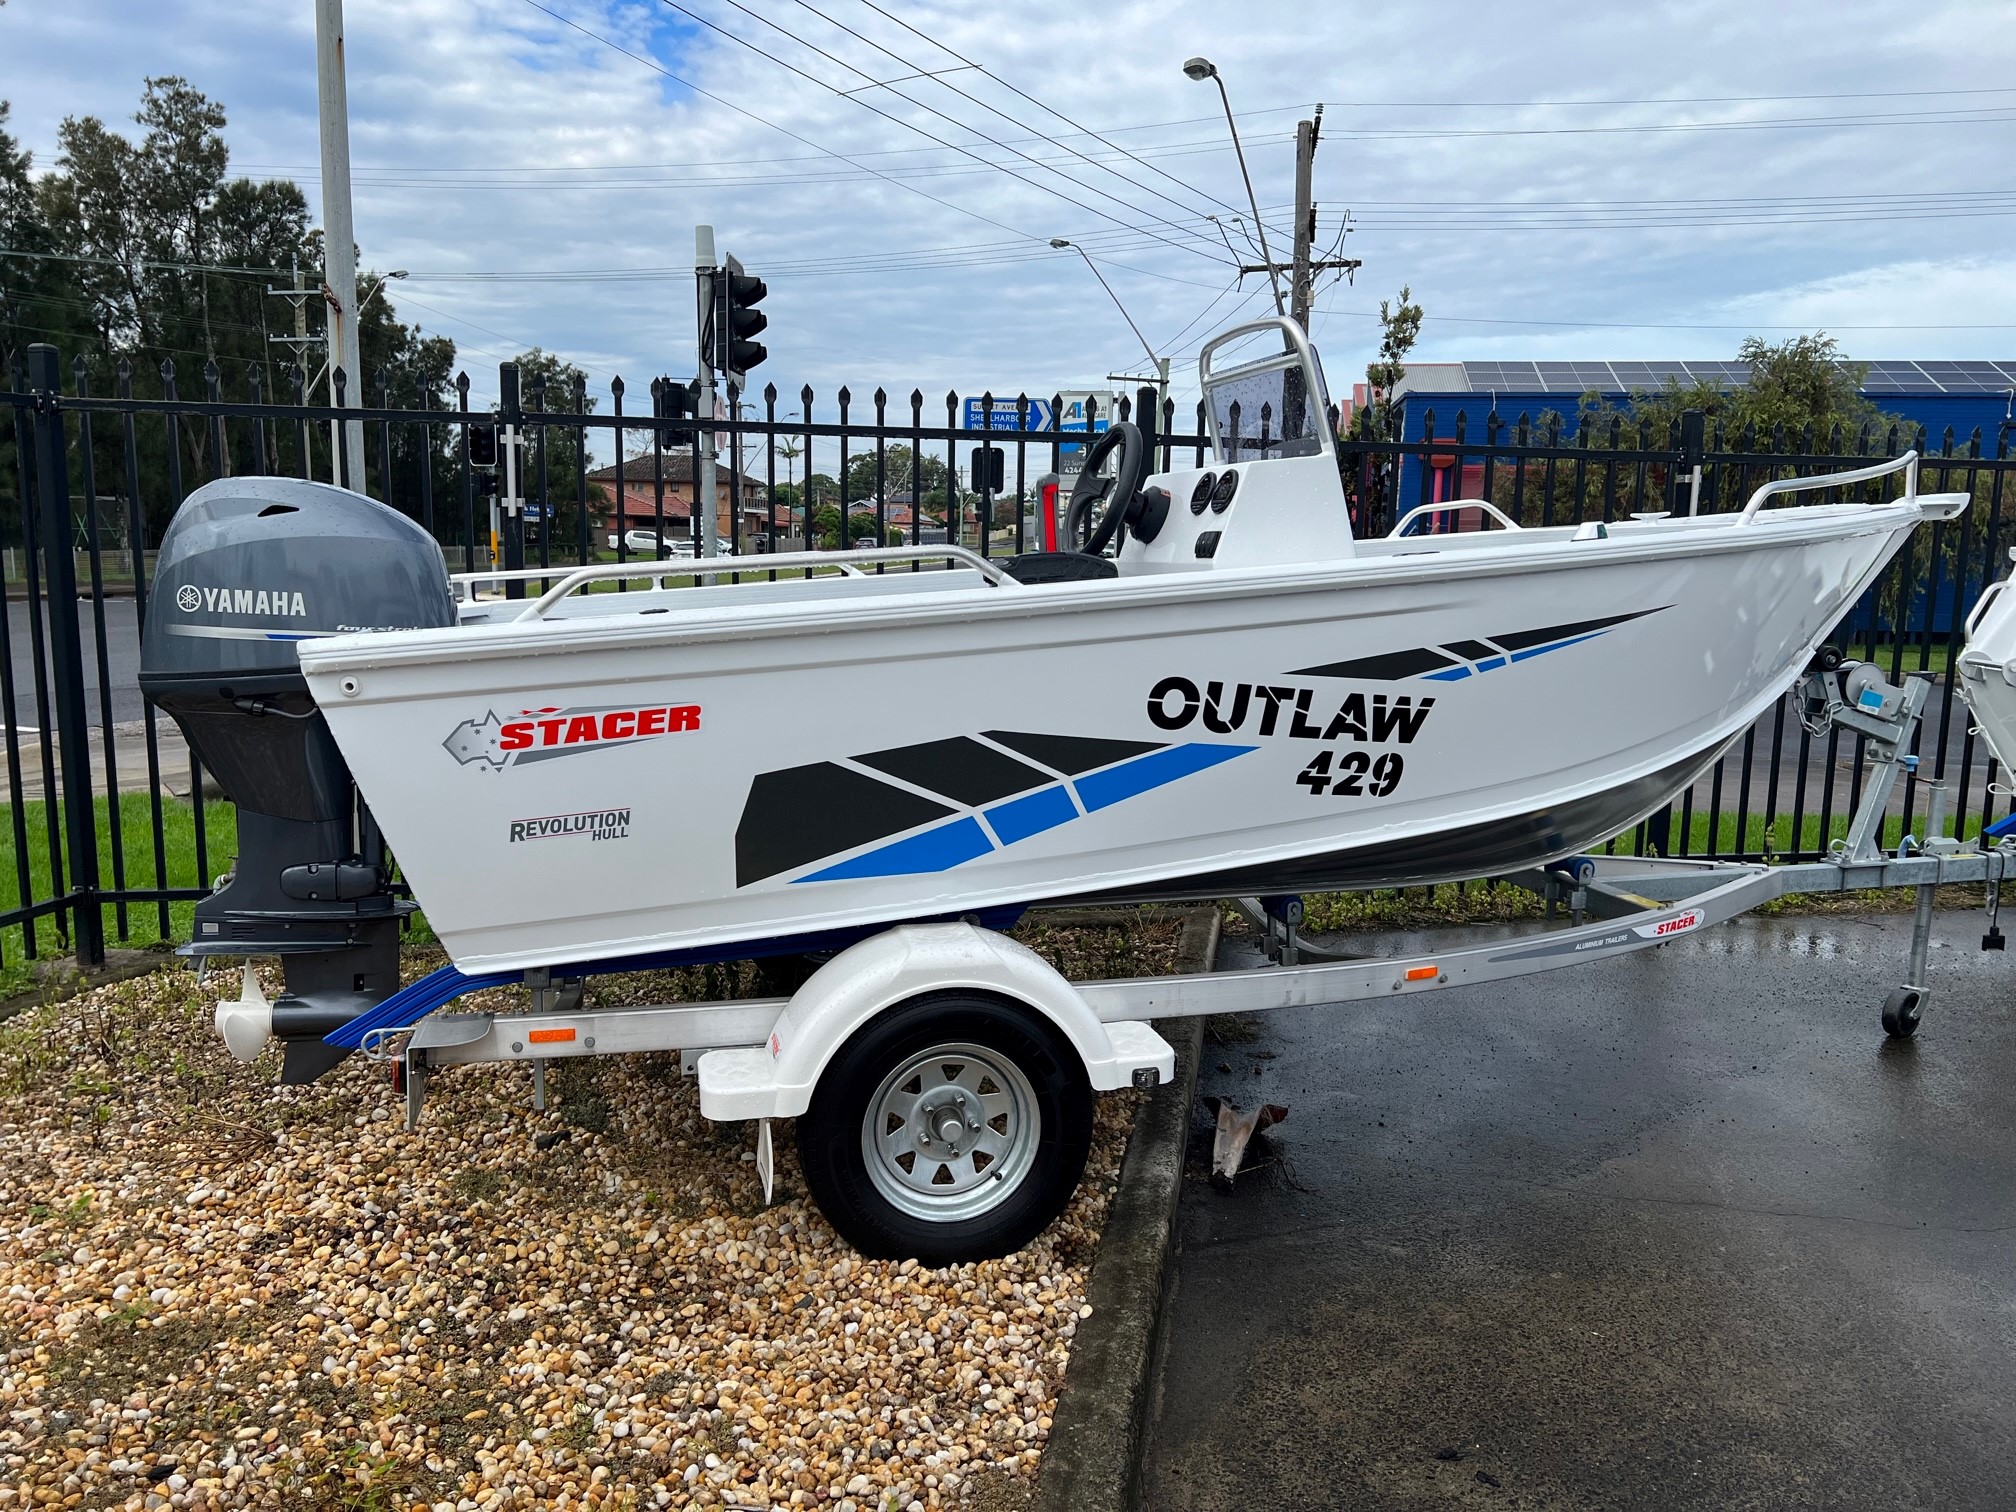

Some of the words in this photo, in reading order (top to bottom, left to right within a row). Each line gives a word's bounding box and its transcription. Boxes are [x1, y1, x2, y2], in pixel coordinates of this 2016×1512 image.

[971, 423, 1014, 431] INDSTRIAL
[203, 587, 306, 616] YAMAHA
[1147, 676, 1436, 744] OUTLAW
[500, 705, 702, 750] STACER
[1296, 751, 1404, 797] 429
[510, 810, 631, 842] REVOLUTION
[592, 826, 628, 841] HULL
[1605, 934, 1628, 945] TRAILERS
[1657, 915, 1696, 935] STACER
